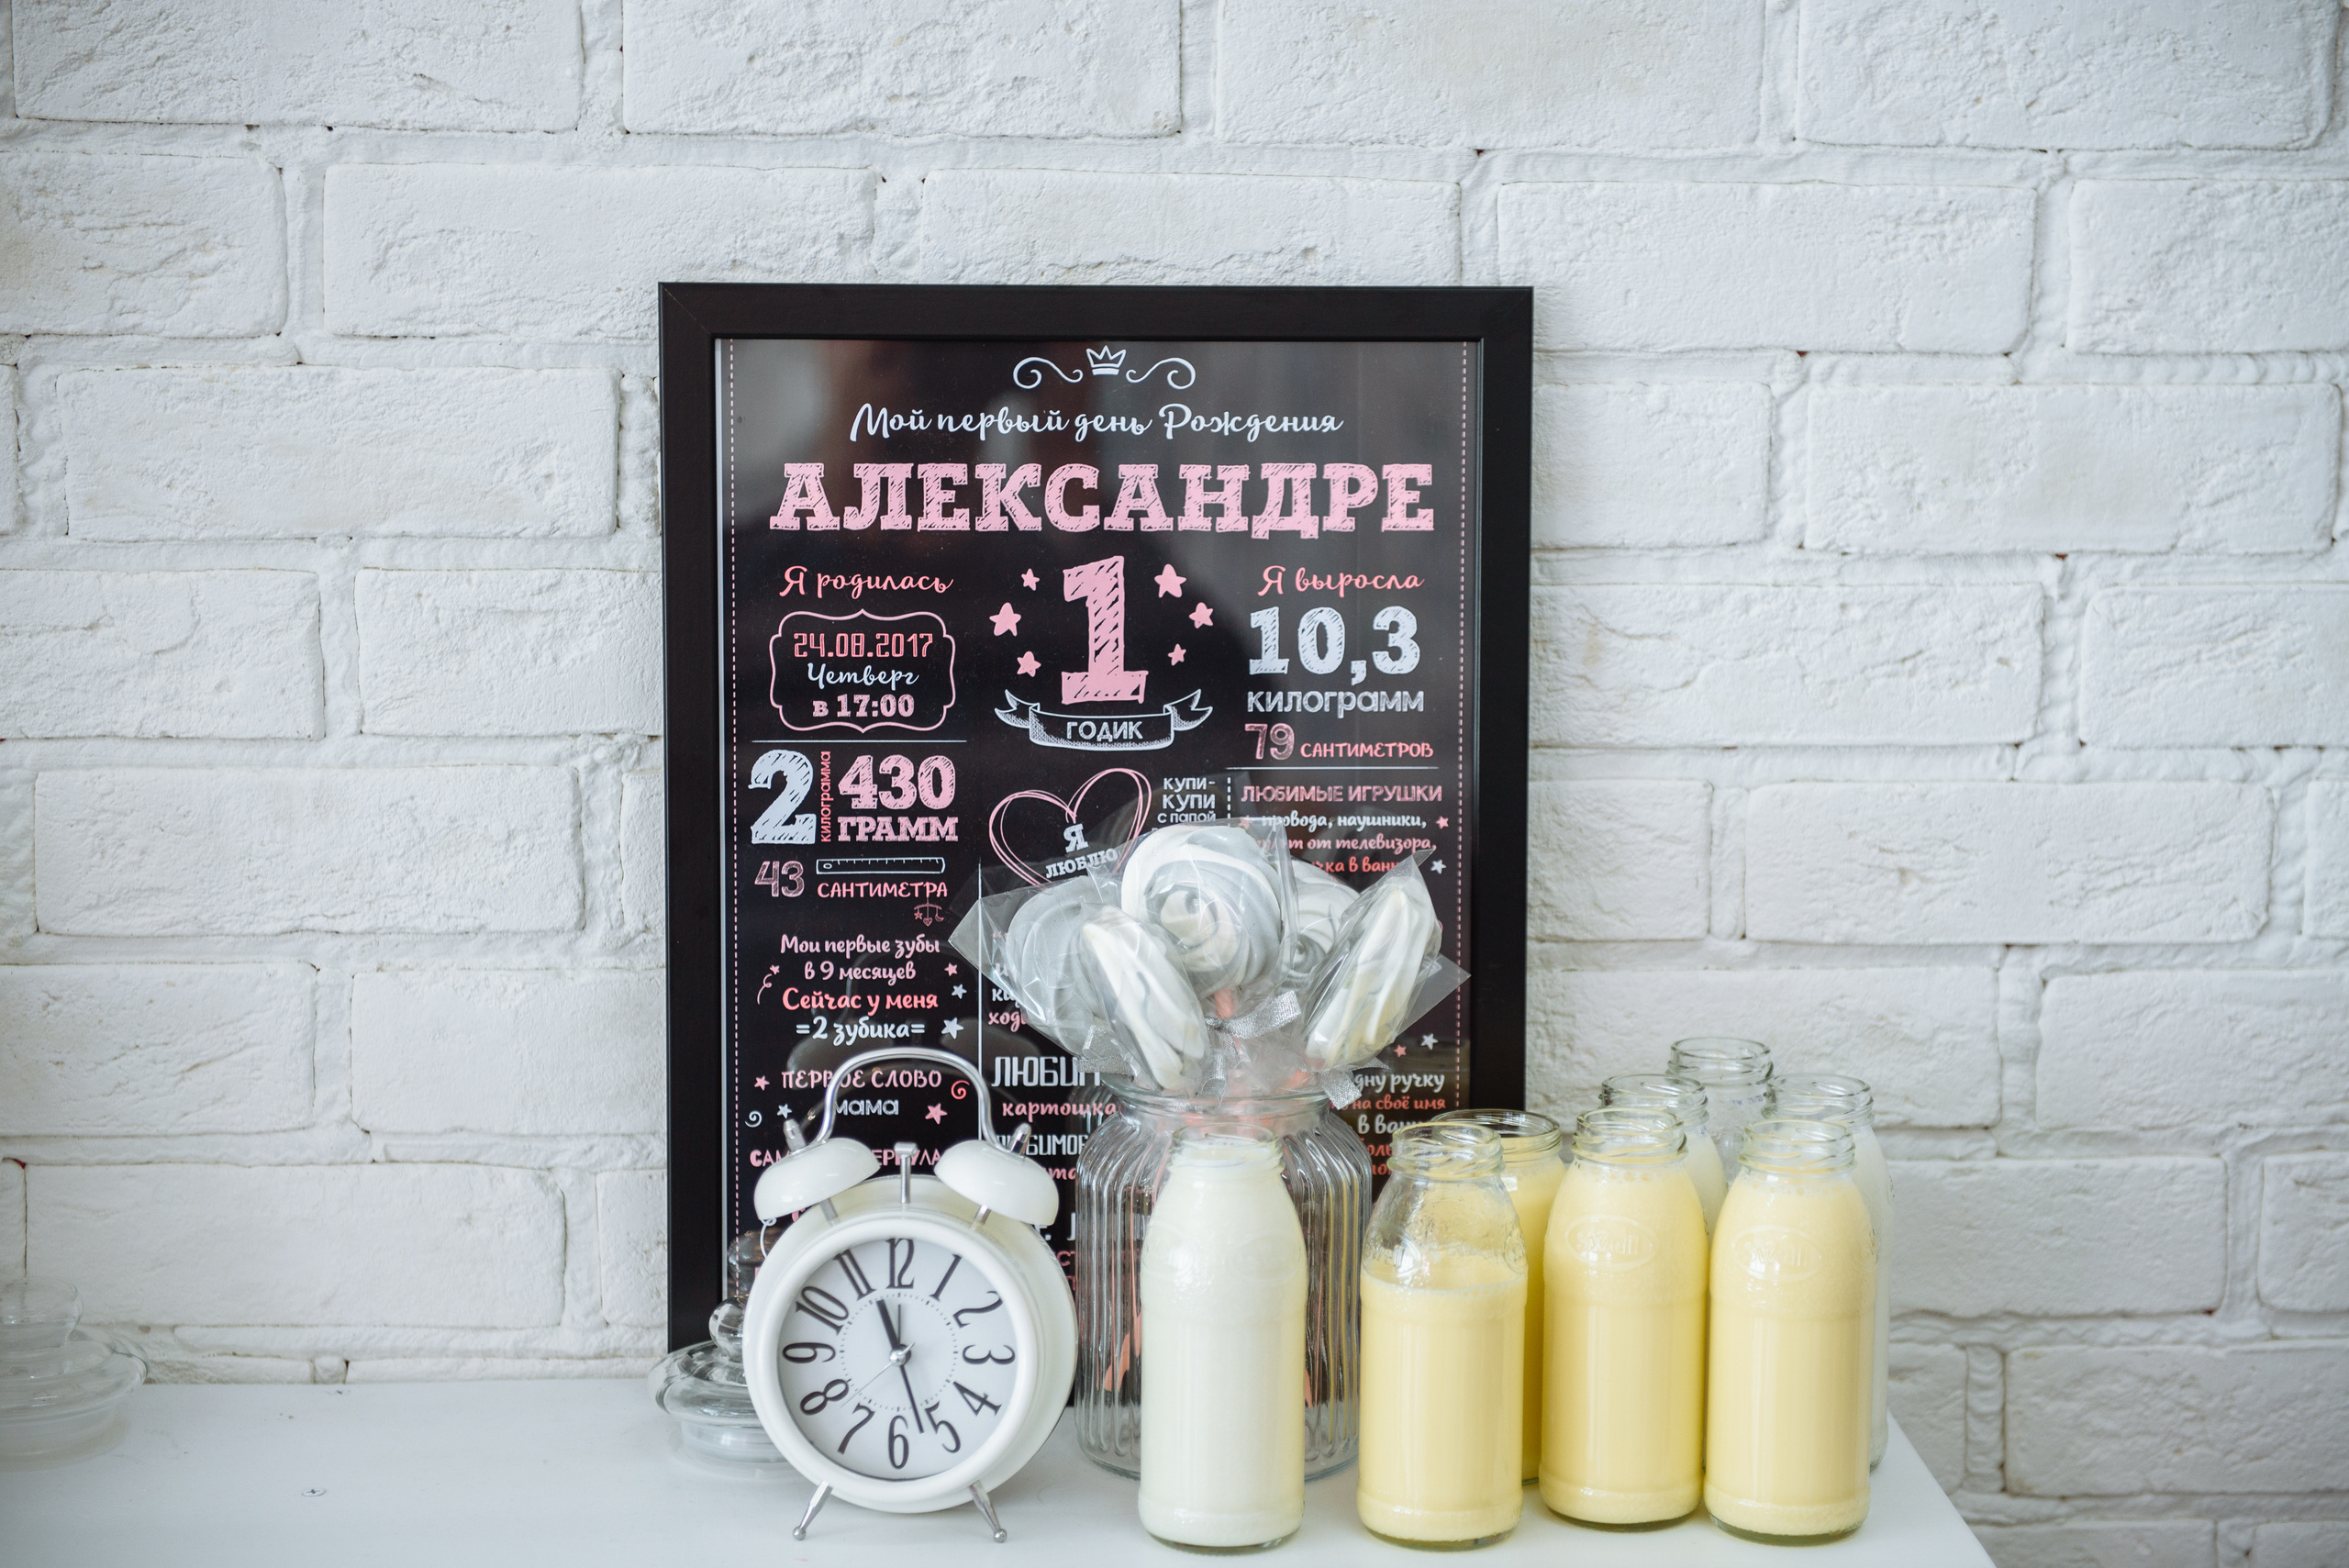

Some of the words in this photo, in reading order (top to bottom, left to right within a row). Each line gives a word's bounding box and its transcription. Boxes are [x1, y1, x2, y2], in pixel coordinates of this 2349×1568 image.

[850, 404, 932, 441] Мой
[938, 406, 1069, 440] первый
[1074, 414, 1152, 441] день
[1159, 404, 1343, 442] Рождения
[770, 462, 1434, 539] АЛЕКСАНДРЕ
[779, 566, 807, 596] Я
[818, 573, 953, 599] родилась
[1258, 565, 1286, 595] Я
[1296, 567, 1424, 597] выросла
[794, 633, 932, 657] 24.08.2017
[1062, 556, 1149, 705] 1
[1250, 606, 1420, 685] 10,3
[807, 662, 918, 691] Четверг
[837, 694, 914, 717] 17:00
[1245, 723, 1295, 760] 79
[1300, 742, 1433, 757] САНТИМЕТРОВ
[748, 750, 817, 844] 2
[839, 755, 955, 809] 430
[1241, 785, 1343, 802] ЛЮБИМЫЕ
[1349, 785, 1442, 801] ИГРУШКИ
[838, 817, 958, 841] ГРАММ
[1063, 824, 1088, 852] Я
[1337, 816, 1426, 831] наушники,
[1307, 839, 1331, 850] от
[1335, 832, 1437, 855] телевизора,
[754, 861, 804, 897] 43
[818, 882, 947, 898] САНТИМЕТРА
[1348, 855, 1359, 873] в
[781, 934, 820, 953] Мои
[825, 934, 890, 959] первые
[895, 934, 940, 959] зубы
[805, 962, 815, 979] в
[820, 961, 834, 980] 9
[840, 961, 917, 986] месяцев
[783, 987, 862, 1010] Сейчас
[866, 995, 881, 1017] у
[885, 995, 938, 1009] меня
[871, 1070, 942, 1089] СЛОВО
[1353, 1074, 1386, 1093] дну
[1390, 1073, 1445, 1093] ручку
[1002, 1102, 1117, 1123] картошка
[1375, 1094, 1410, 1110] своё
[1414, 1099, 1446, 1110] имя
[1358, 1114, 1370, 1134] в
[885, 1237, 916, 1290] 12
[929, 1253, 963, 1303] 1
[795, 1285, 851, 1336] 10
[952, 1290, 1004, 1329] 2
[782, 1340, 837, 1364] 9
[963, 1343, 1017, 1366] 3
[799, 1377, 851, 1417] 8
[952, 1380, 1003, 1418] 4
[836, 1402, 876, 1455] 7
[887, 1414, 910, 1471] 6
[923, 1400, 963, 1454] 5
